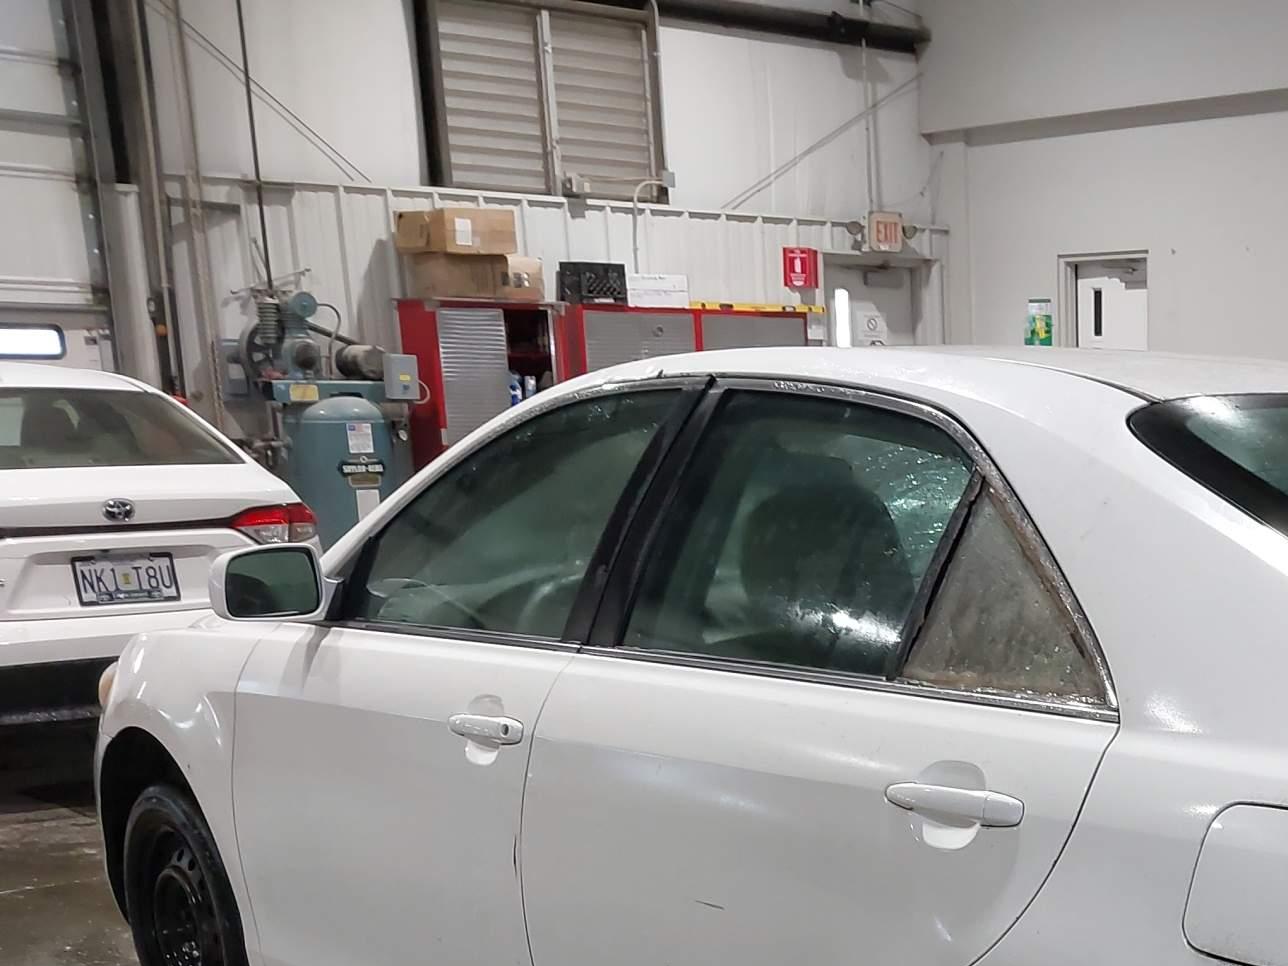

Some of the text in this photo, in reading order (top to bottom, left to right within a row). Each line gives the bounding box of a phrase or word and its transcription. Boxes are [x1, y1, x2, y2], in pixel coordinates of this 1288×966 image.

[876, 220, 899, 244] EXIT
[80, 565, 173, 594] NK1 T8U
